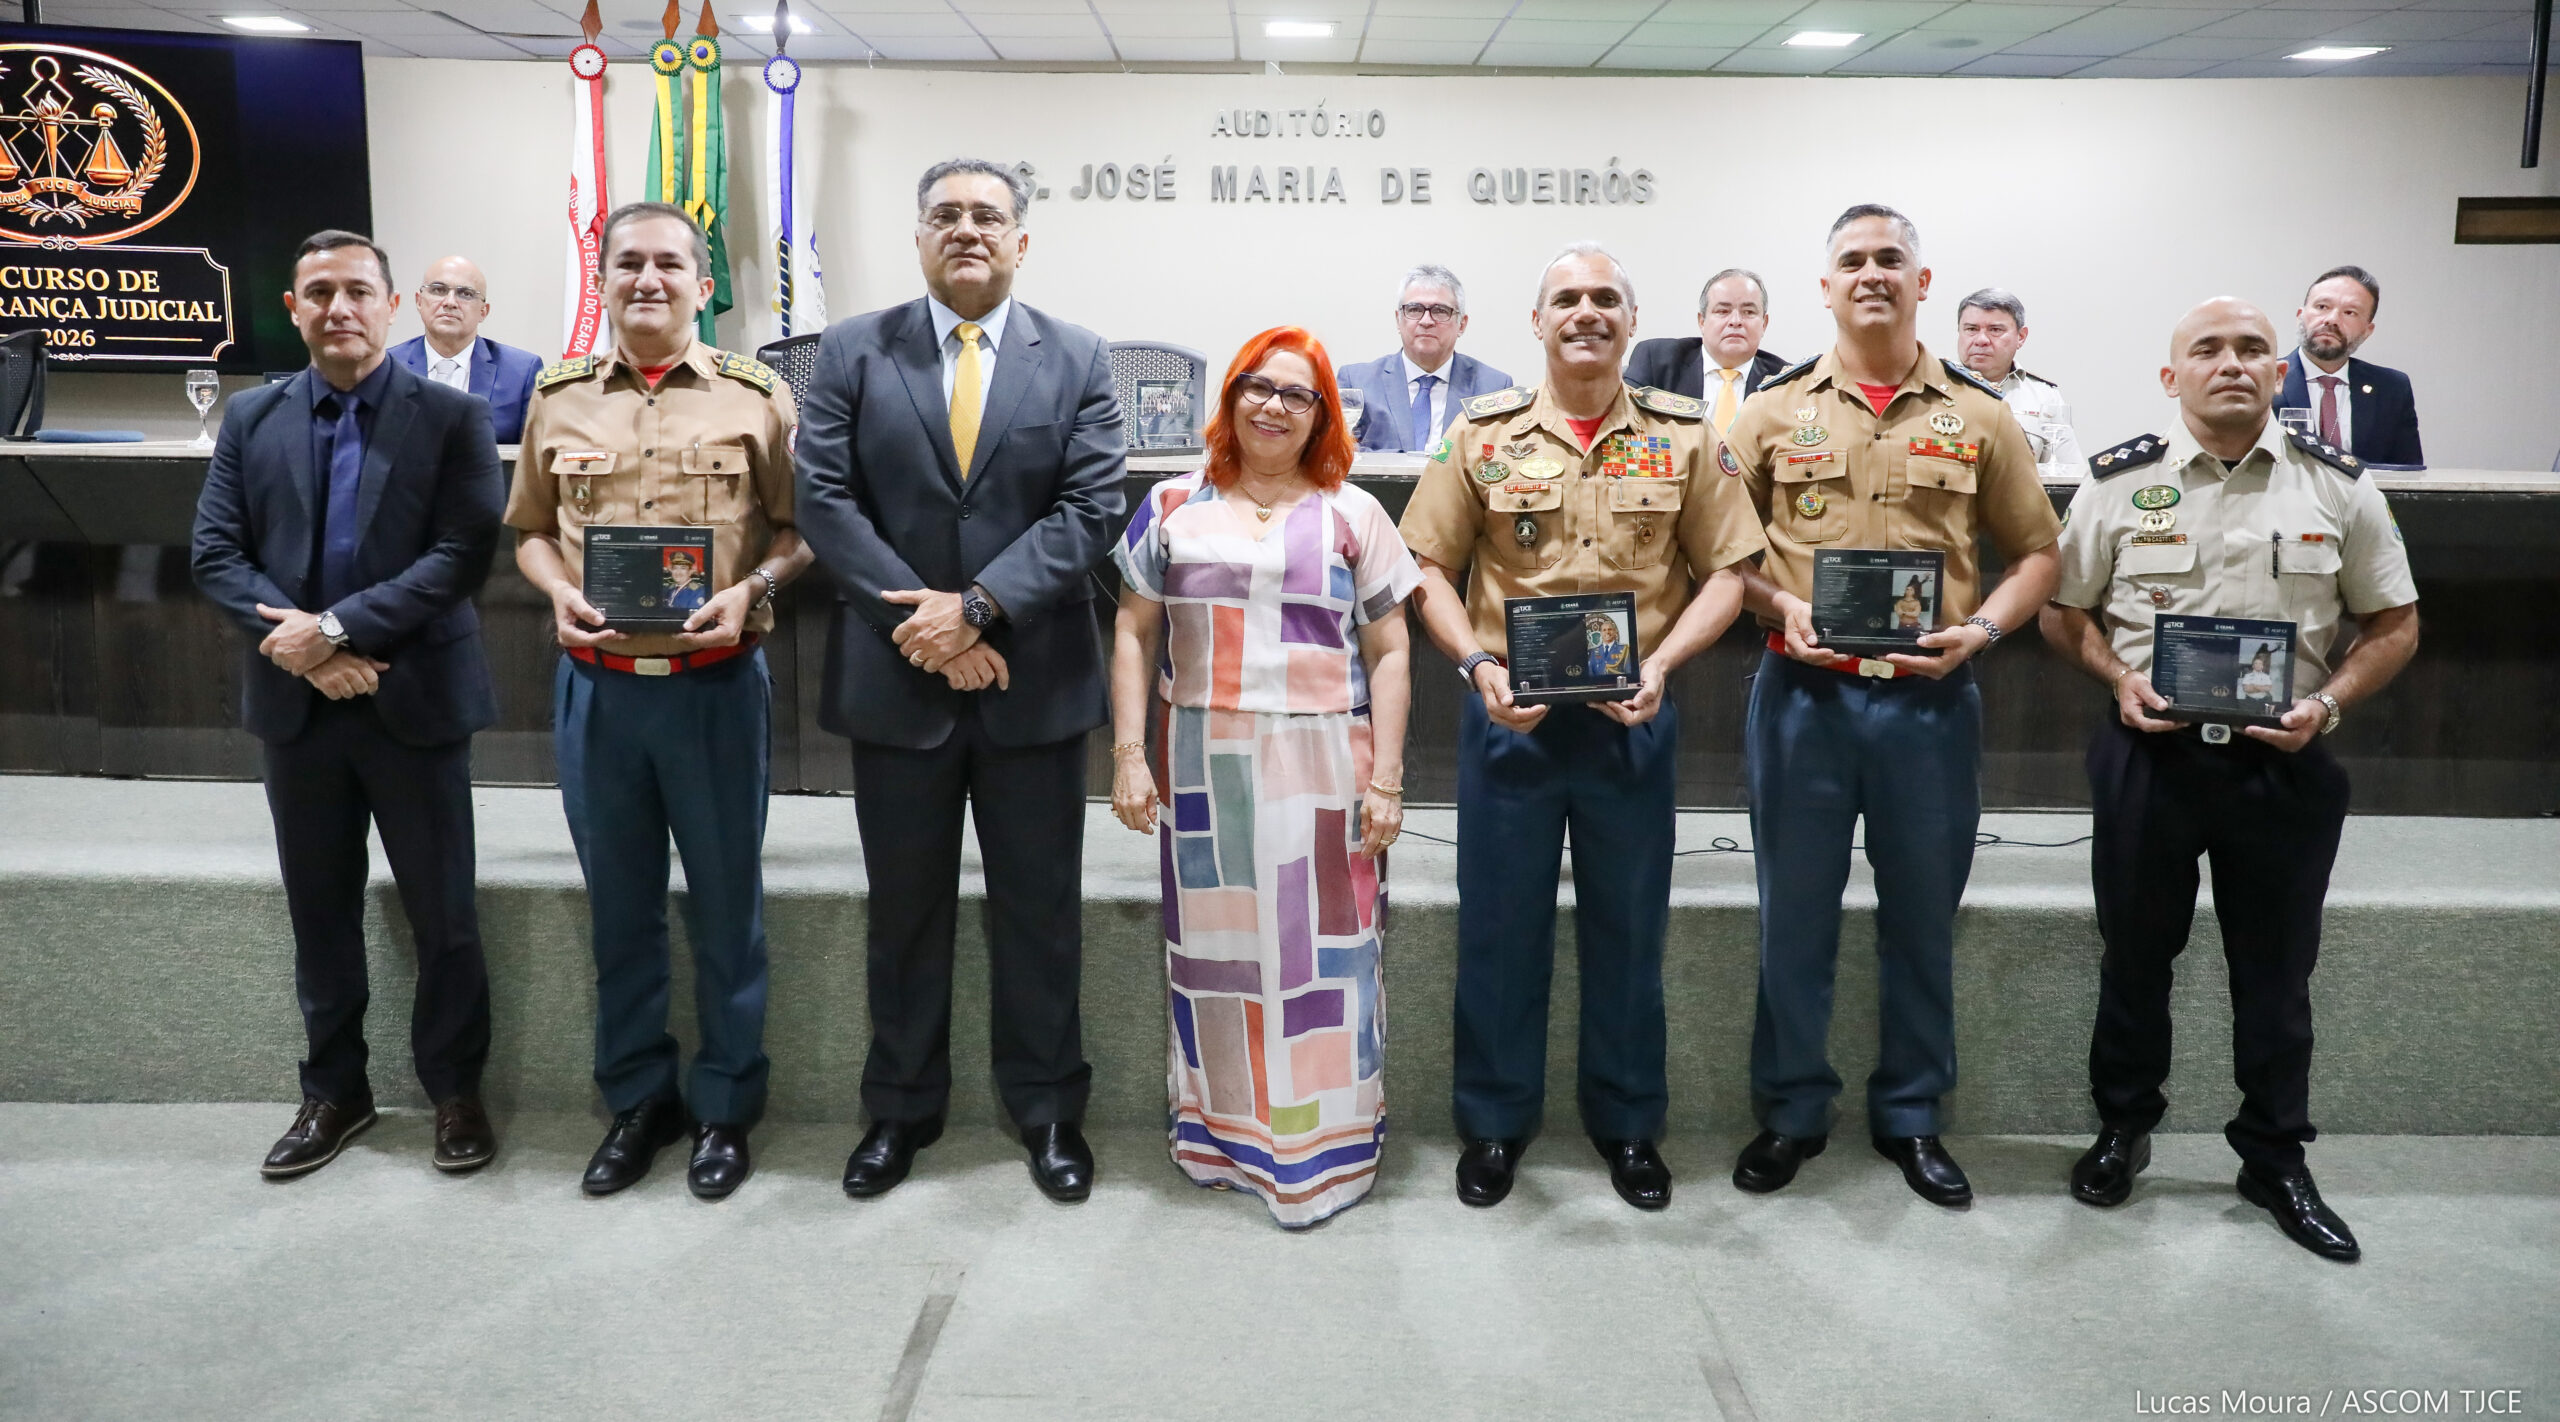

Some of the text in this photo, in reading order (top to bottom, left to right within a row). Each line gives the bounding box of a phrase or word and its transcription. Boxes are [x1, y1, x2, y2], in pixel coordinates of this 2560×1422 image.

[1211, 97, 1385, 137] AUDITÓRIO
[37, 181, 75, 192] TJCE
[1003, 154, 1655, 205] S. JOSÉ MARIA DE QUEIRÓS
[0, 193, 28, 204] ANÇA
[85, 196, 136, 208] JUDICIAL
[0, 266, 160, 292] CURSO DE
[96, 296, 223, 322] JUDICIAL
[584, 297, 598, 315] DO
[571, 316, 595, 354] CEARÁ
